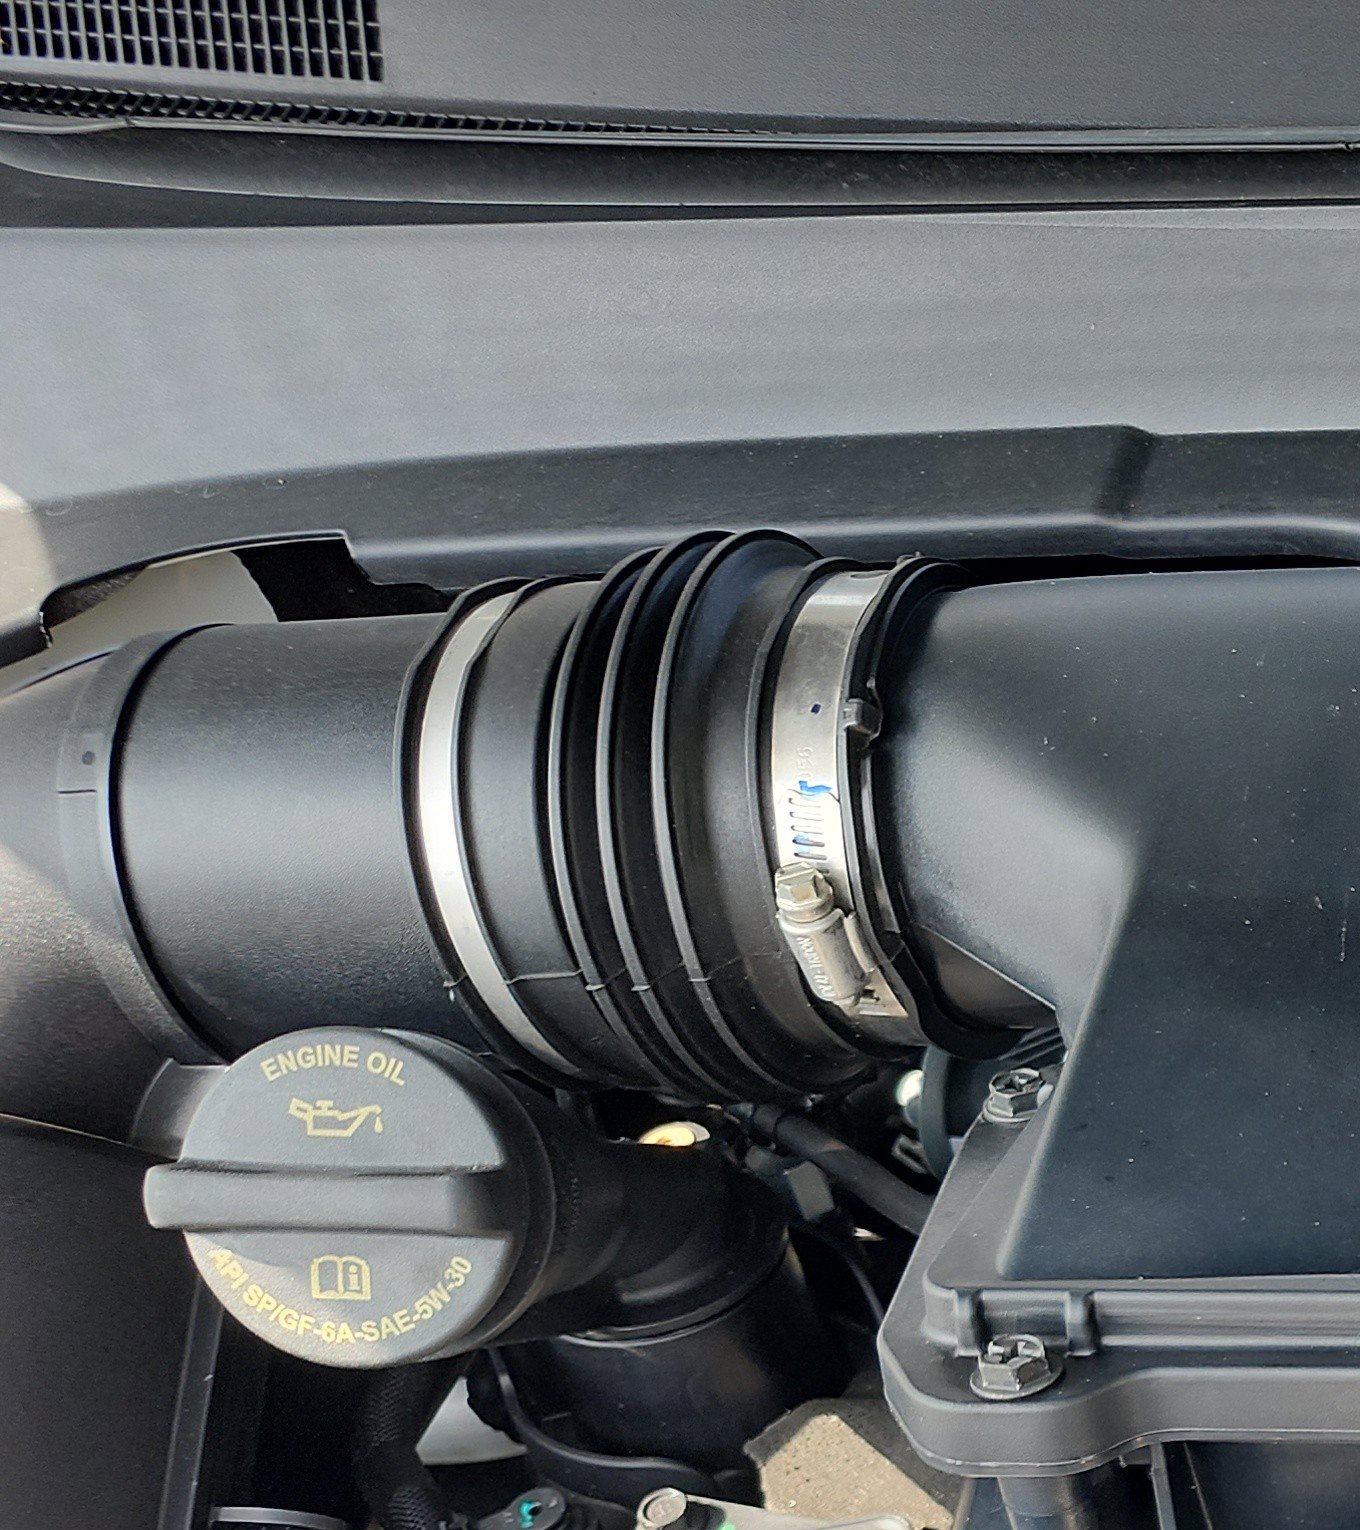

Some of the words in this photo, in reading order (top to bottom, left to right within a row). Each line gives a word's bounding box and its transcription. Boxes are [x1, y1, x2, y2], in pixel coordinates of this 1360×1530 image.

[260, 1044, 360, 1082] ENGINE
[366, 1053, 406, 1086] OIL
[210, 1250, 249, 1289] API
[242, 1255, 473, 1344] SP/GF-6A-SAE-5W-30
